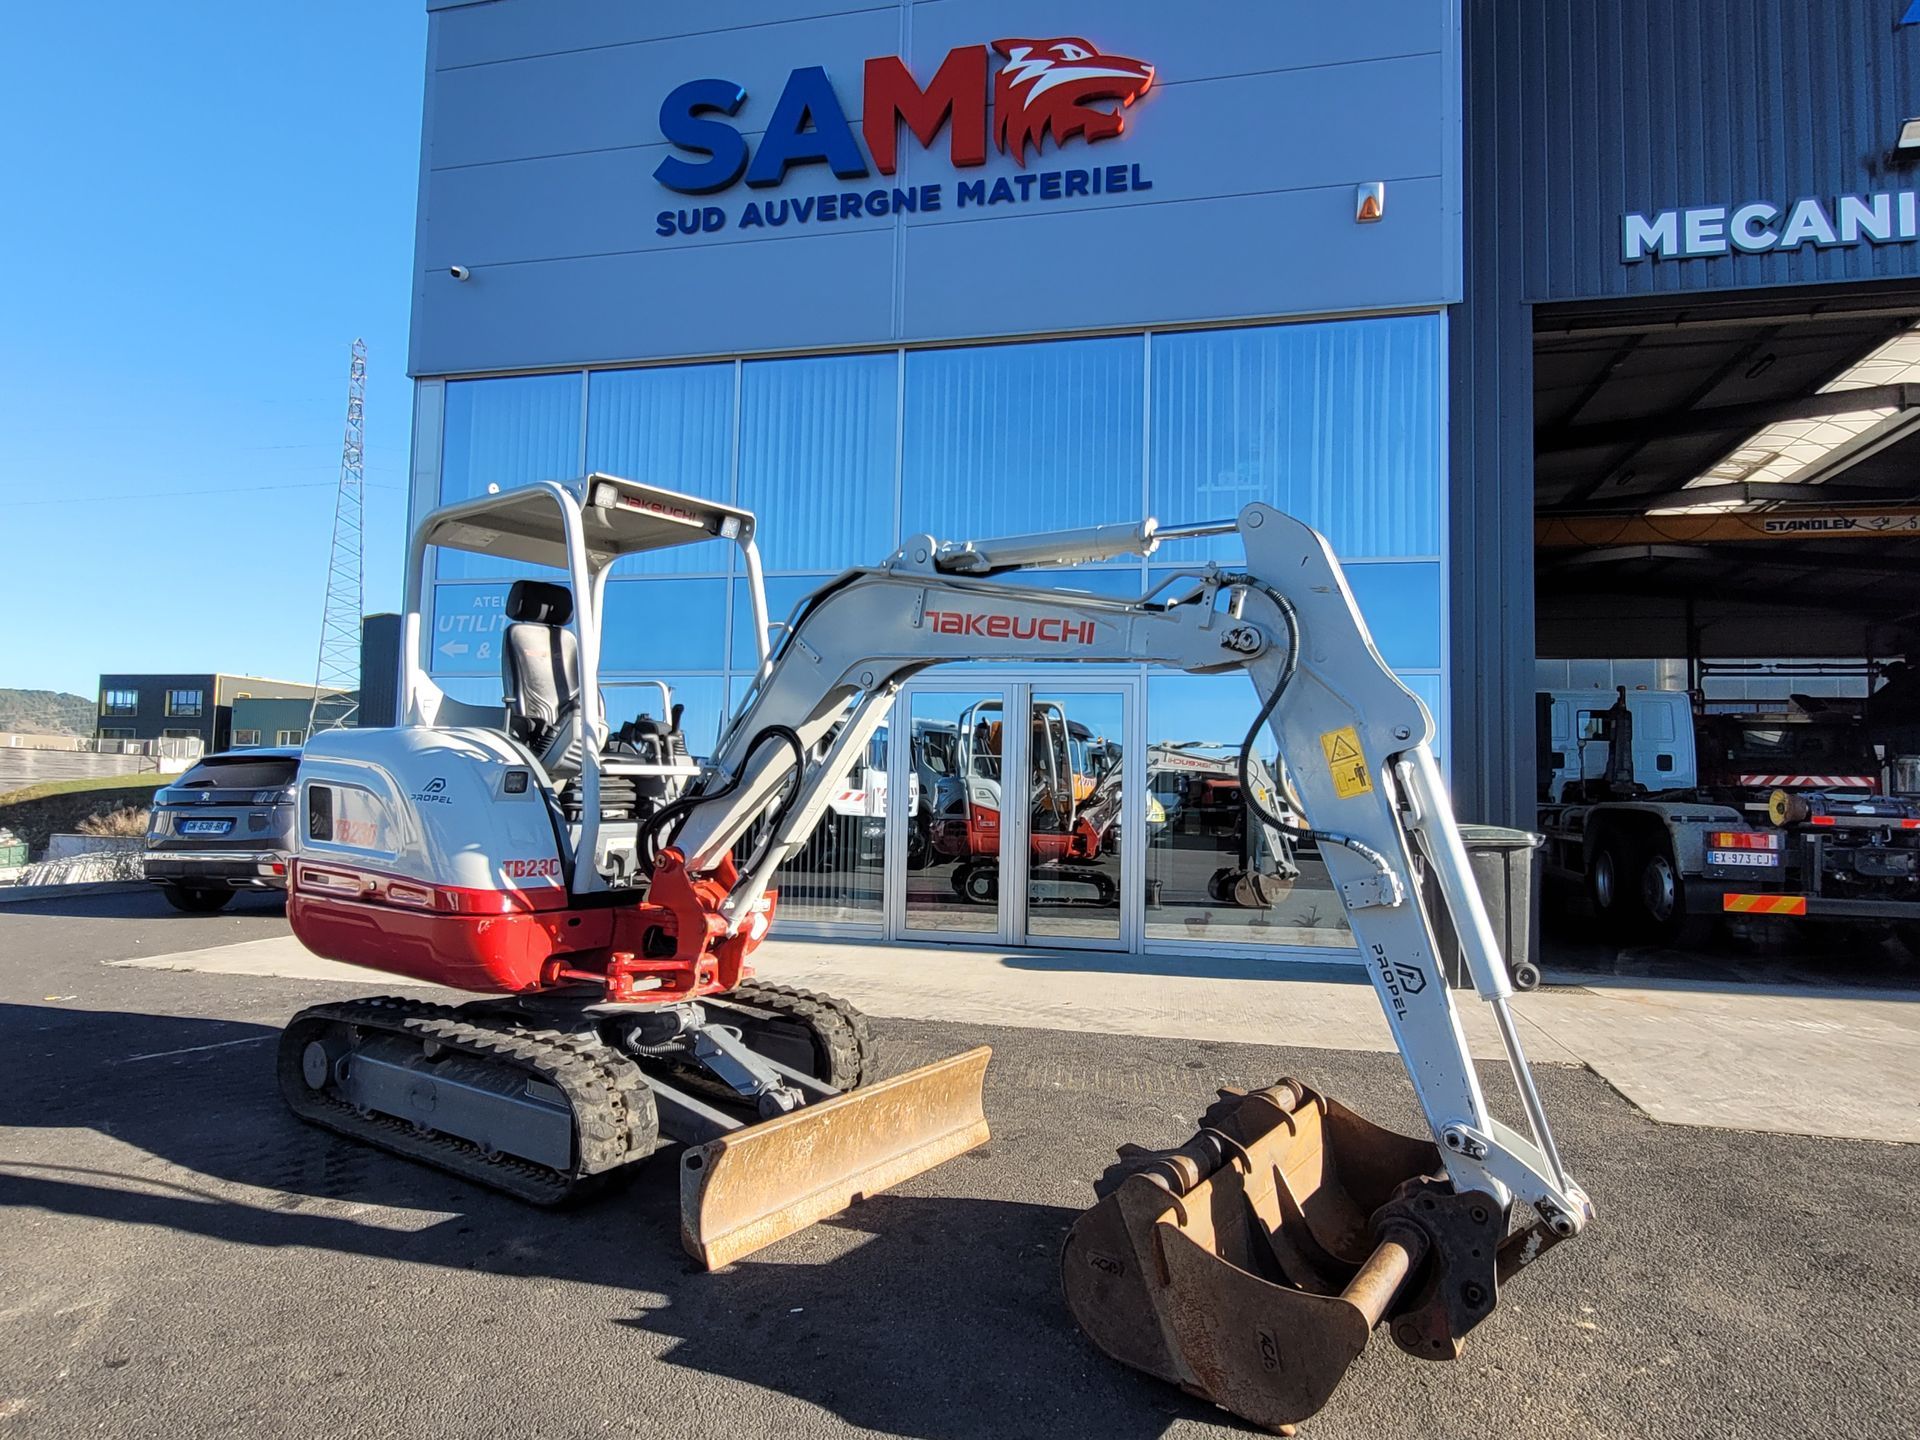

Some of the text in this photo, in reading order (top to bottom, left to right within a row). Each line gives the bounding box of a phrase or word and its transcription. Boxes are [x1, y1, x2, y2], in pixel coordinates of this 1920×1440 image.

[653, 44, 990, 195] SAM
[655, 163, 1153, 237] SUD AUVERGNE MATERIEL
[1625, 192, 1916, 259] MECANI
[411, 793, 453, 804] PROPEL
[1714, 853, 1770, 865] EX-973-CJ
[1372, 943, 1408, 1022] PROPEL
